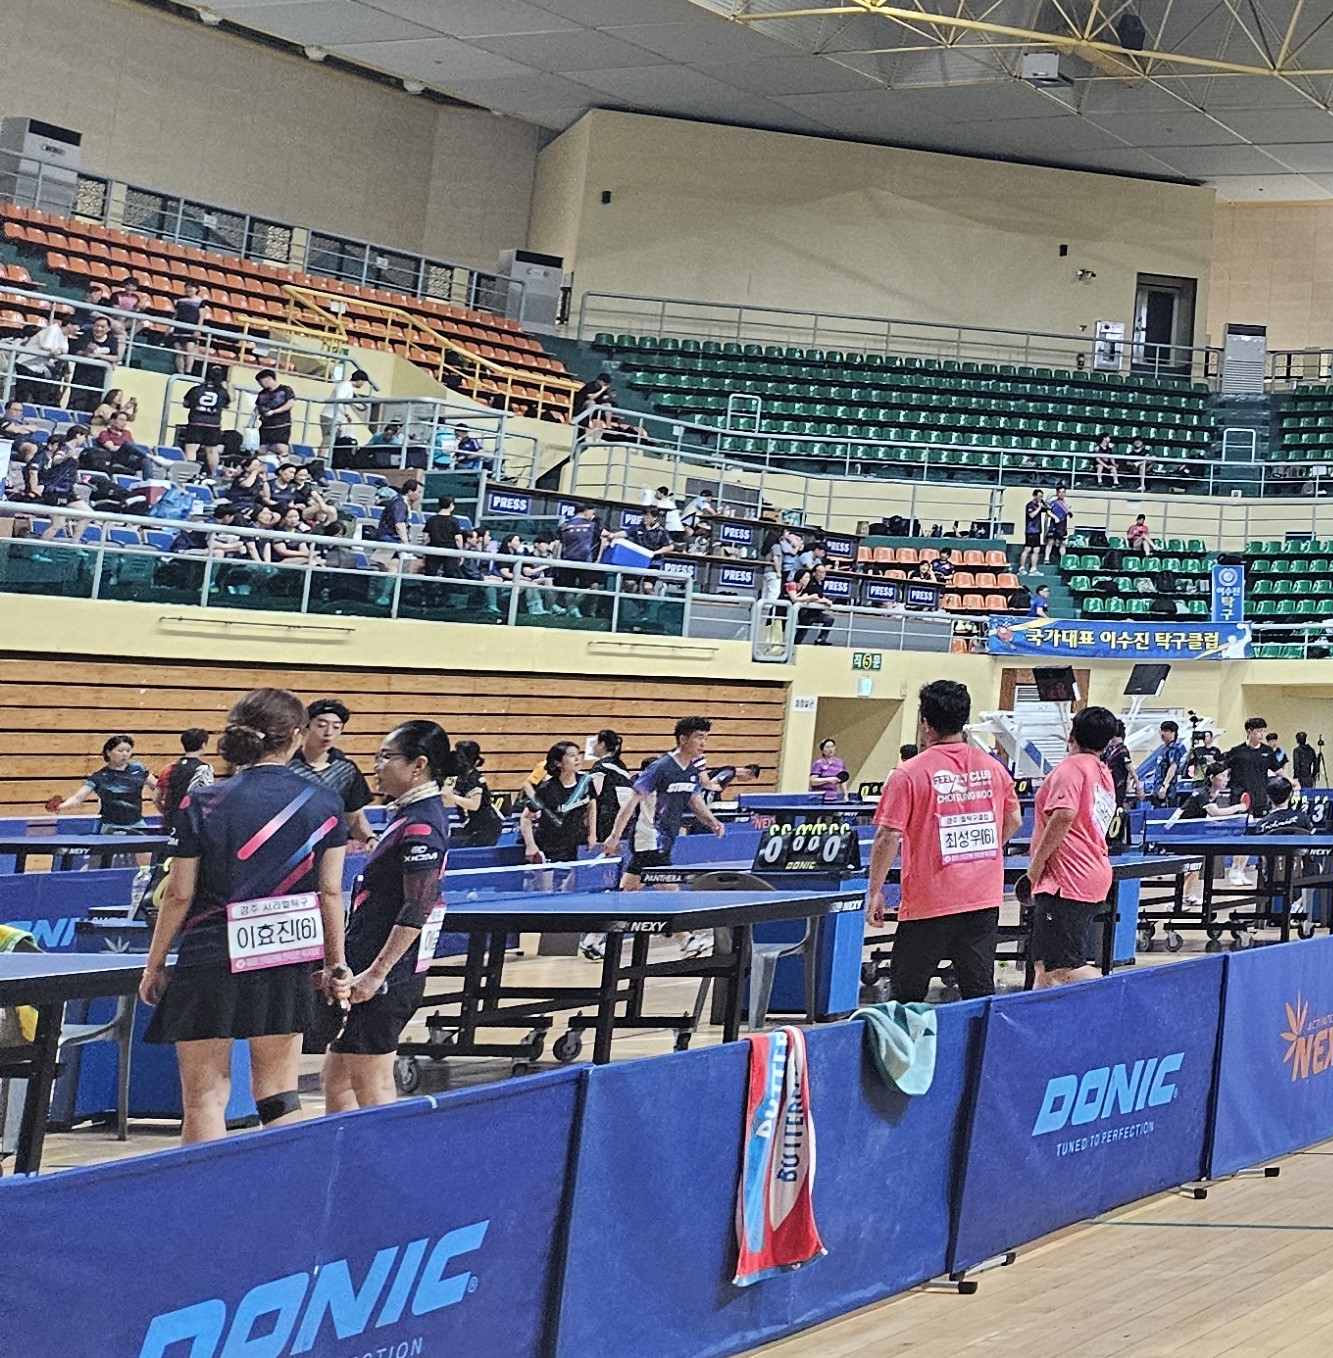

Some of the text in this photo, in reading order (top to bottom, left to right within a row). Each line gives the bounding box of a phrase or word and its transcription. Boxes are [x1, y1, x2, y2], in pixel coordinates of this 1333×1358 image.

[492, 495, 528, 512] PRESS
[724, 526, 750, 541] PRESS
[664, 562, 695, 577] PRESS
[723, 569, 752, 583] PRESS
[823, 580, 849, 593] PRESS
[870, 584, 895, 598] PRESS
[1216, 586, 1241, 596] 이수진
[911, 589, 935, 603] PRESS
[1026, 628, 1219, 651] 국가대표 이수진 탁구클럽
[970, 769, 992, 783] CLUB
[1312, 803, 1325, 823] 3
[945, 827, 994, 849] 최성우(6)
[763, 835, 841, 863] 0 0 0 0
[1309, 848, 1333, 857] NEXY
[403, 851, 438, 863] XIOM
[785, 860, 816, 870] DONIC
[842, 900, 864, 912] NEXY
[630, 920, 668, 932] NEXY
[236, 917, 317, 950] 이효진(6)
[1031, 1051, 1186, 1137] DONIC
[1056, 1121, 1154, 1157] TUNED TO PERFECTION
[137, 1219, 490, 1358] DONIC
